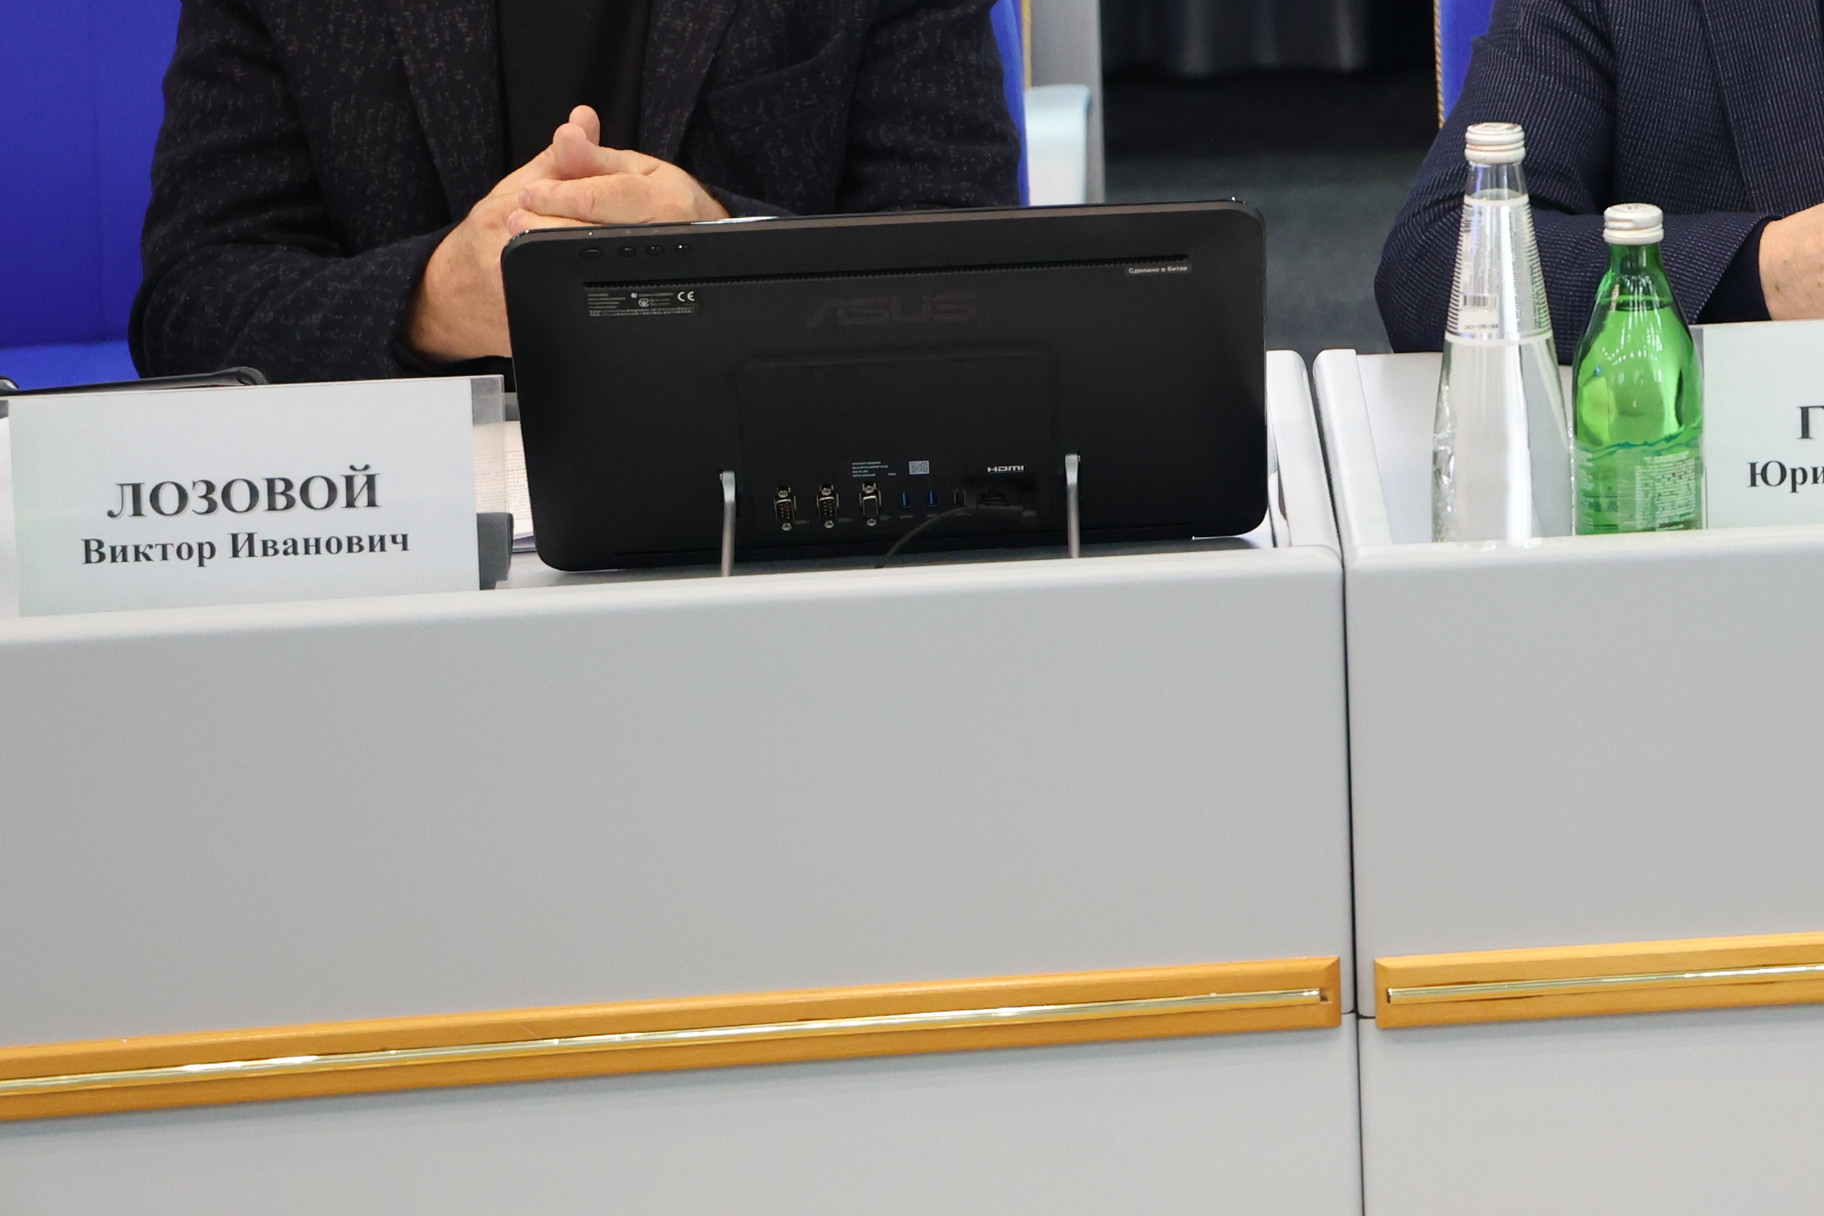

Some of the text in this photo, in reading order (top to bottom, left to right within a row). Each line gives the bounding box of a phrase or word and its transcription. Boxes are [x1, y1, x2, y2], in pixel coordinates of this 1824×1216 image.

[987, 464, 1025, 473] HDMI
[106, 463, 381, 519] ЛОЗОВОЙ
[81, 532, 410, 568] Виктор Иванович
